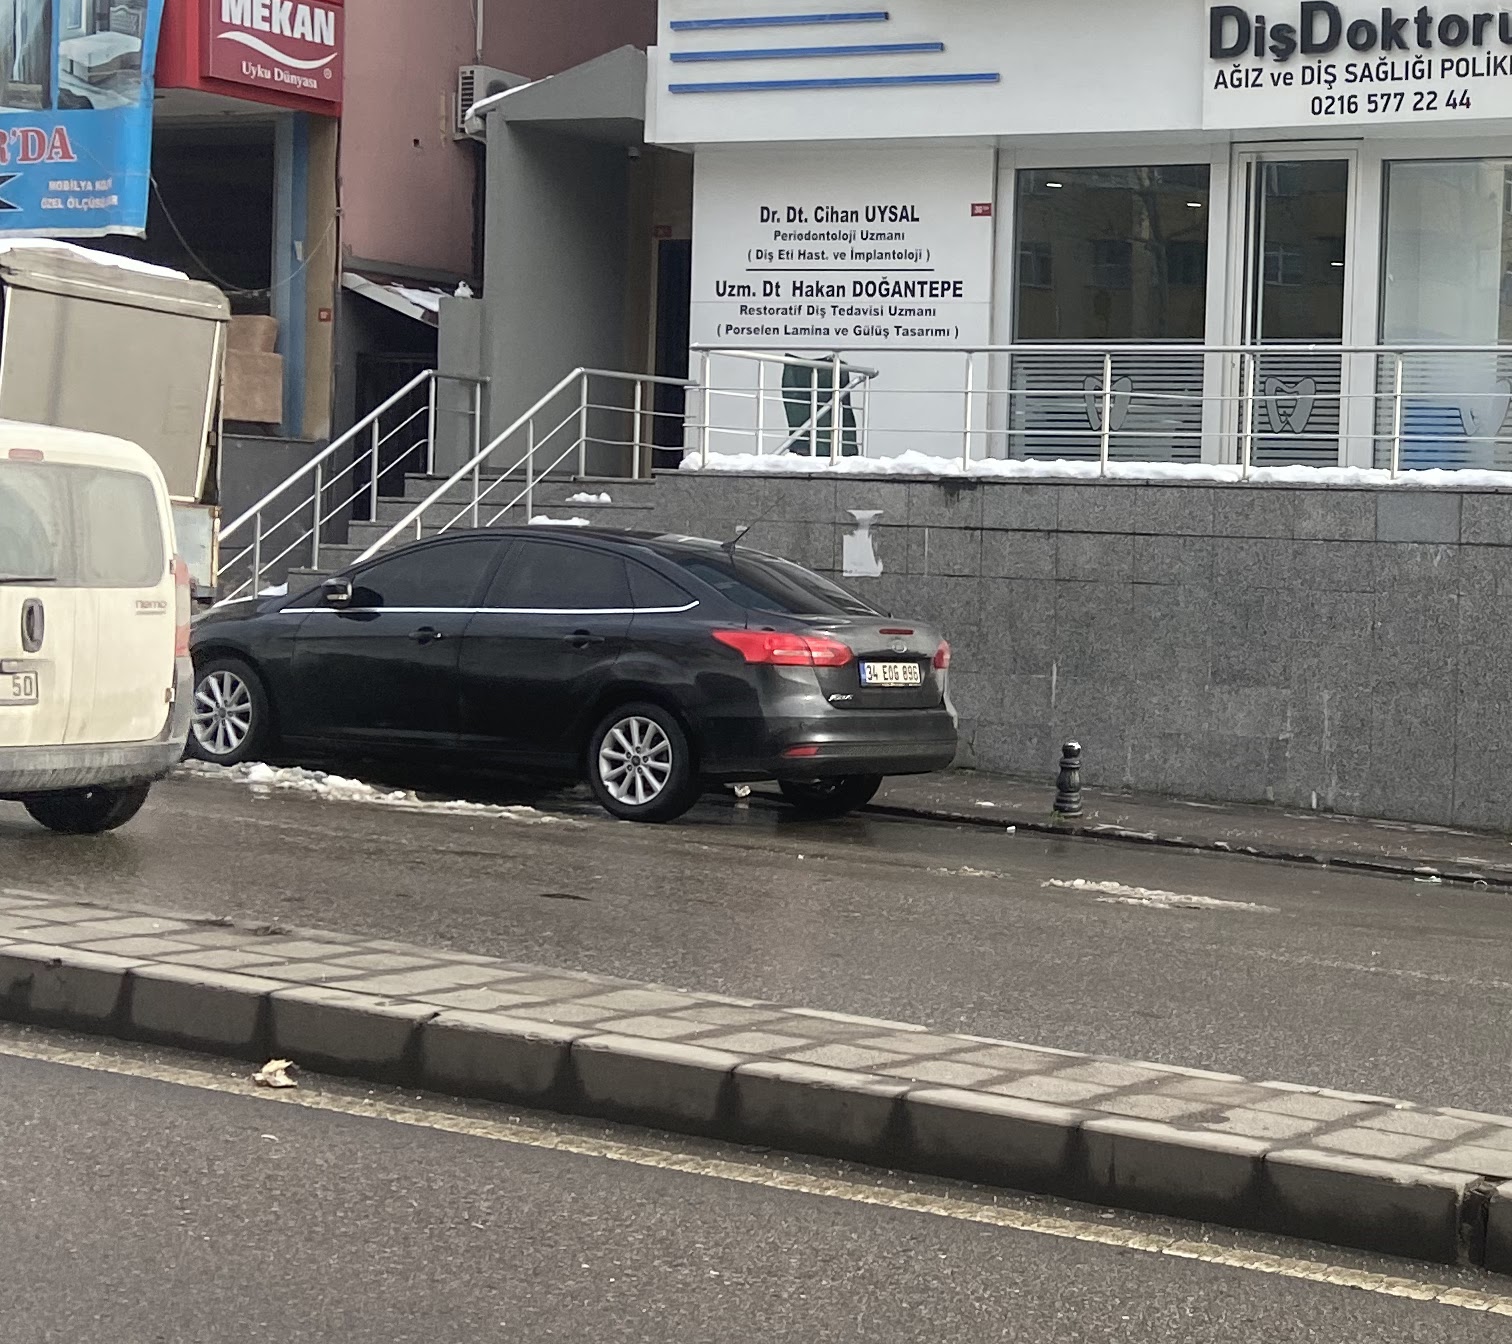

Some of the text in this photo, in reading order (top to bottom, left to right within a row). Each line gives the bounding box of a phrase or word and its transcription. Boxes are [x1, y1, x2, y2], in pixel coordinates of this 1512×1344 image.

[241, 60, 318, 89] Uyku Dünyası
[1213, 64, 1264, 90] AĞIZ
[1269, 71, 1294, 87] ve
[1301, 59, 1337, 89] DİŞ
[1344, 56, 1433, 84] SAĞLIĞI
[1311, 89, 1472, 116] 0216 577 22 44
[760, 205, 920, 223] Dr. Dt. Cihan UYSAL
[773, 230, 905, 244] Periodontoloji Uzmanı
[778, 249, 794, 261] Eti
[797, 249, 829, 261] Hast.
[833, 251, 847, 261] ve
[715, 275, 963, 299] Uzm. Dt Hakan DOĞANTEPE
[739, 304, 937, 319] Restoratif Diş Tedavisi Uzmanı
[784, 325, 830, 336] Lamina
[834, 327, 849, 337] ve
[853, 325, 890, 339] Gülüş
[866, 664, 879, 681] 34
[12, 675, 33, 697] 50
